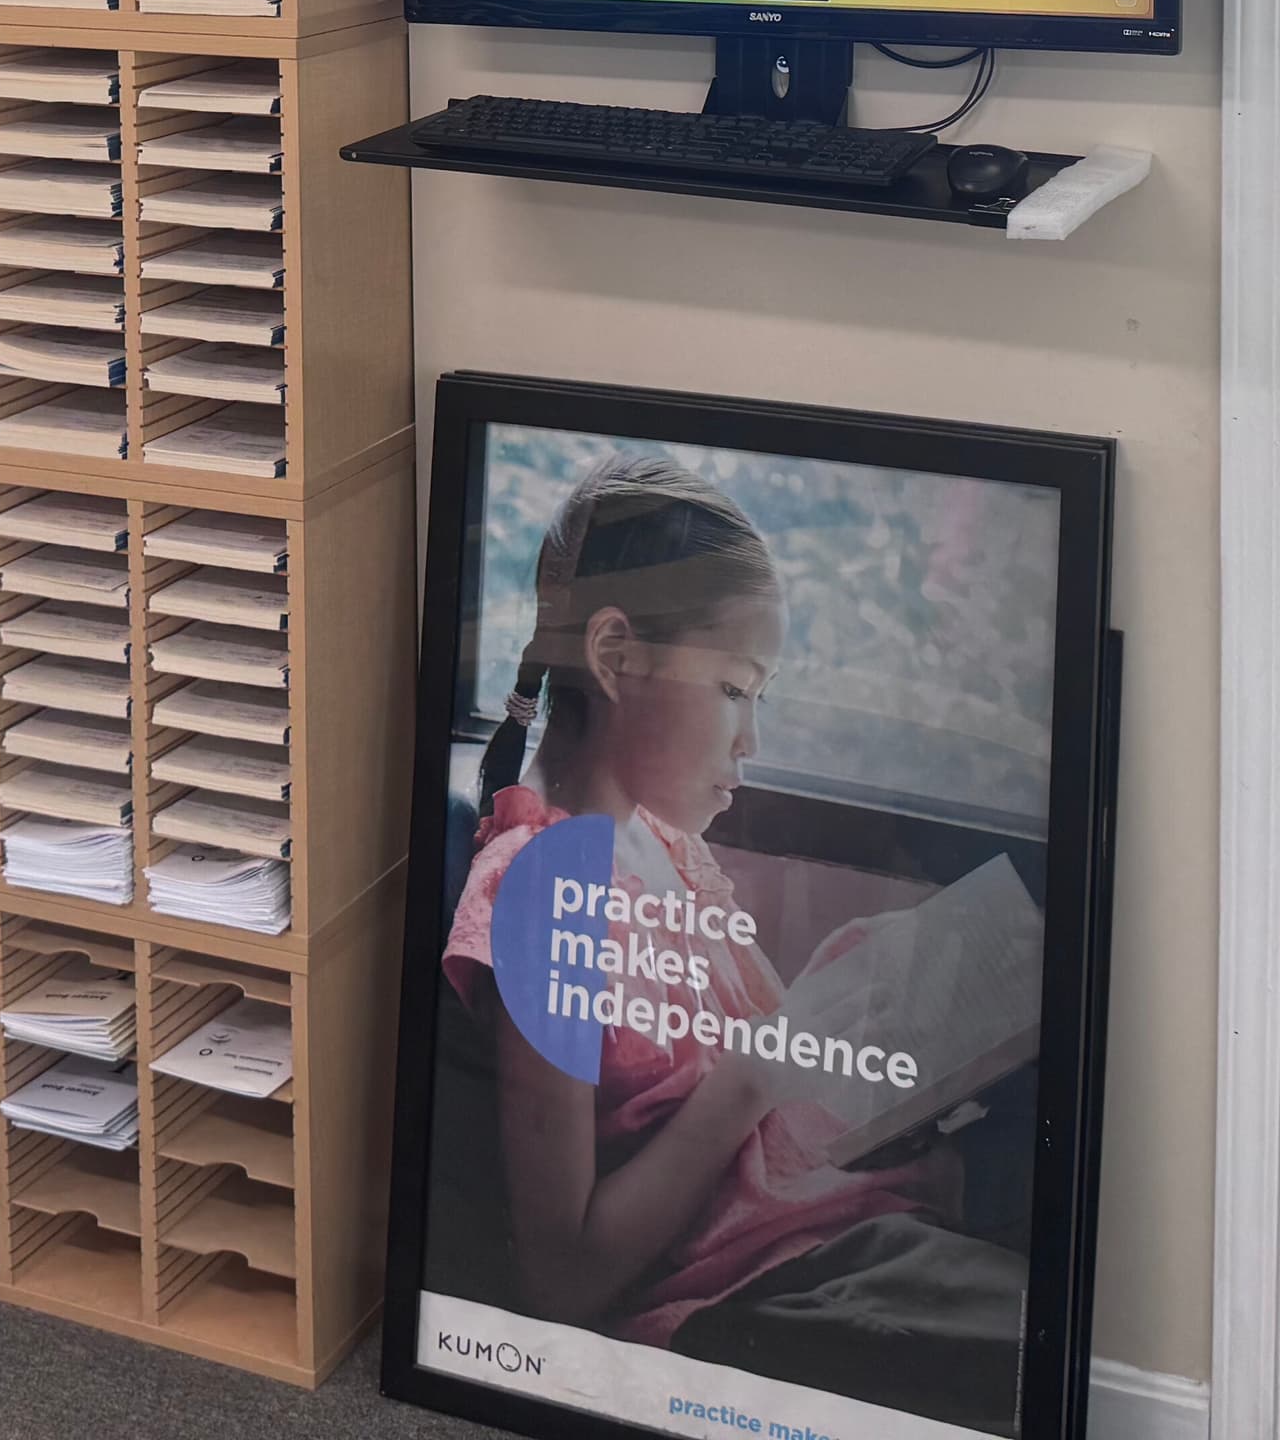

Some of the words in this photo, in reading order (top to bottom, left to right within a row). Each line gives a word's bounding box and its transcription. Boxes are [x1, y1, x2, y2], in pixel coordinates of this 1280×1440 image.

[749, 12, 782, 23] SANYO
[552, 876, 757, 945] practice
[550, 928, 710, 991] makes
[547, 972, 919, 1088] independence
[438, 1331, 543, 1375] KUMON
[669, 1396, 762, 1433] practice
